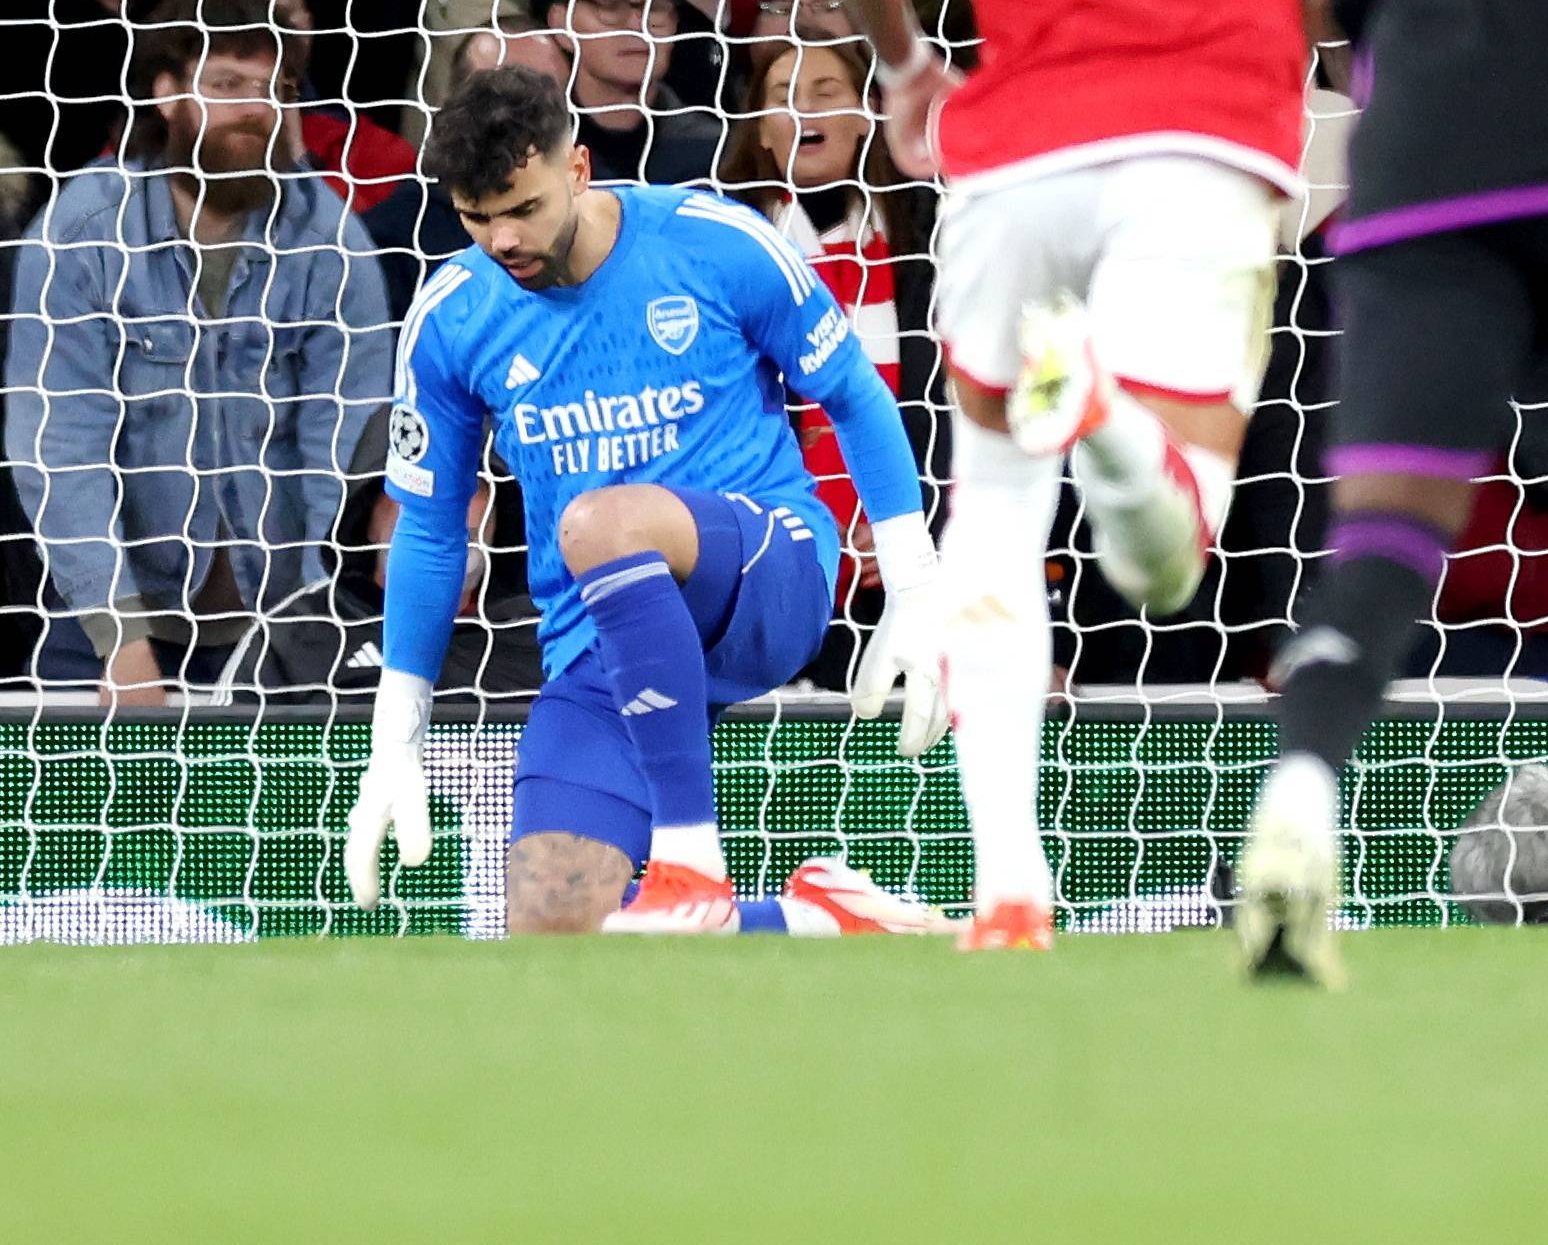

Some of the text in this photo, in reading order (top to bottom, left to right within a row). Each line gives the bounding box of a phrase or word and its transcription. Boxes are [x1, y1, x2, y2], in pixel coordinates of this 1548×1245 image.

[798, 316, 851, 376] RWAND
[805, 305, 839, 347] VISIT
[514, 380, 705, 445] Emirates
[551, 423, 681, 476] FLY BETTER
